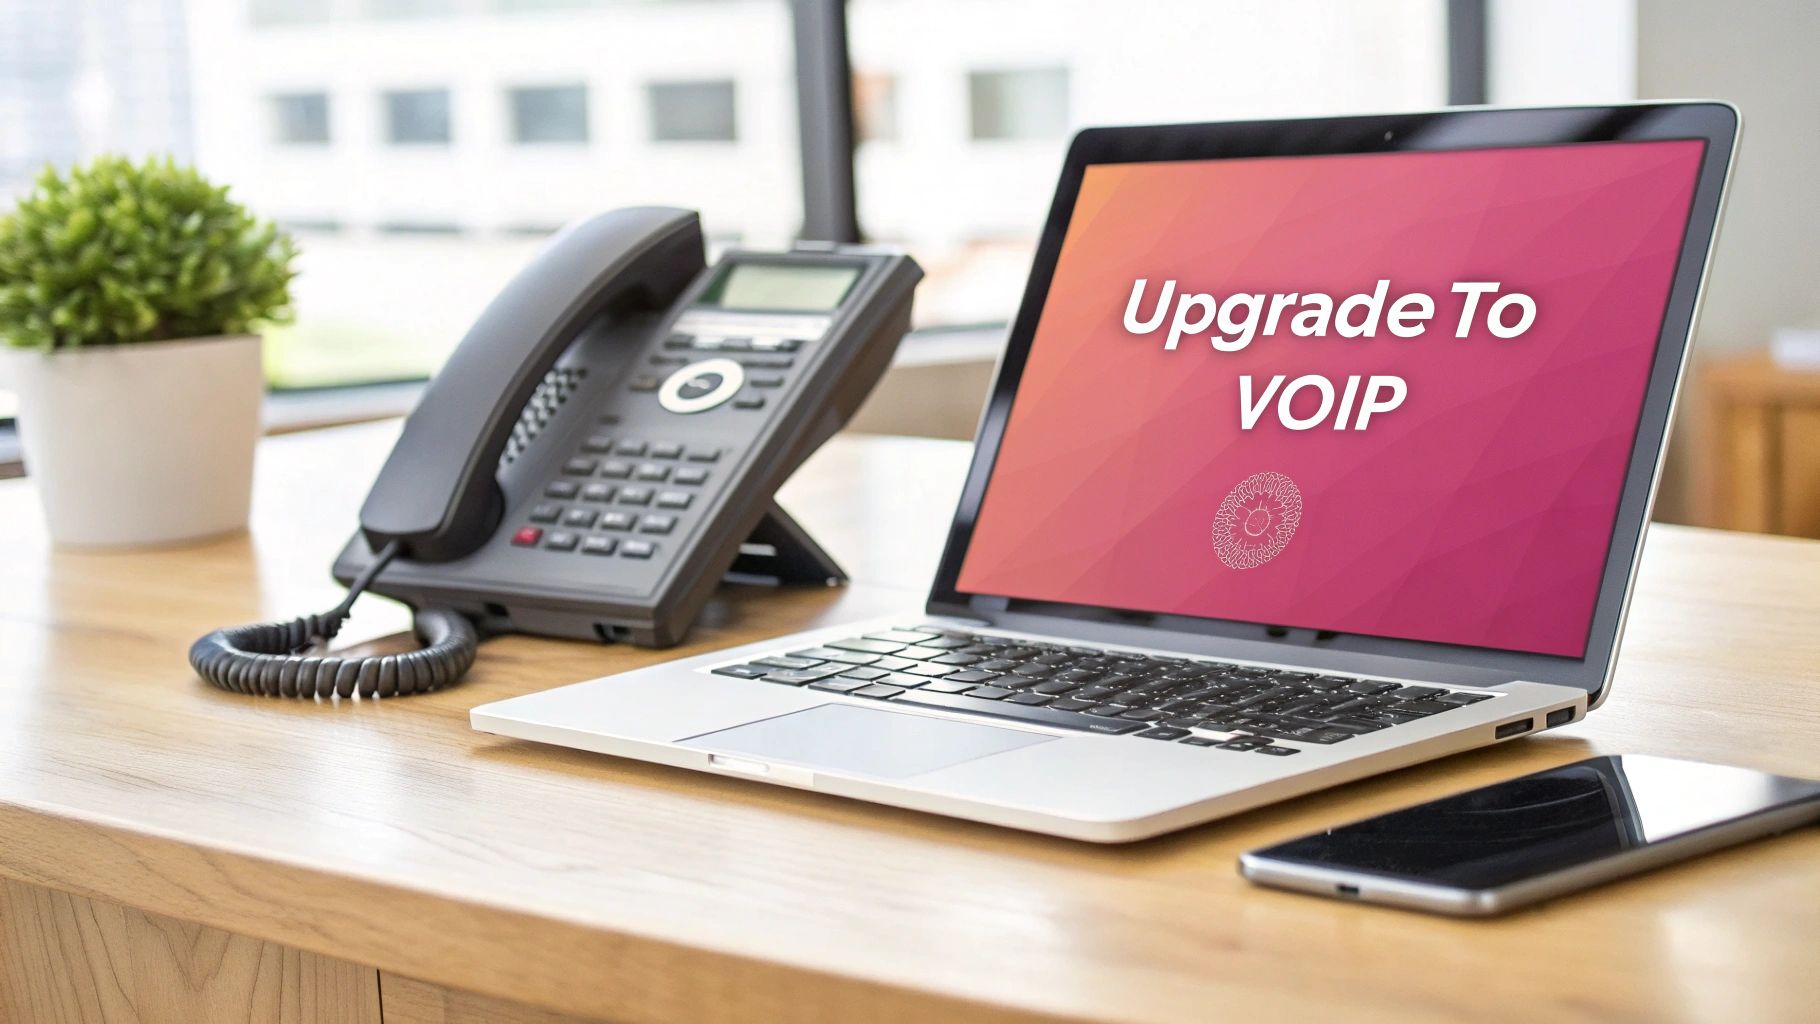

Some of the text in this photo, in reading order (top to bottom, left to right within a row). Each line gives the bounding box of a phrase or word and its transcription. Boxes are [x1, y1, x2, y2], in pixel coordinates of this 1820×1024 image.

[1123, 278, 1537, 352] Upgrade To
[1238, 375, 1408, 431] VOIP
